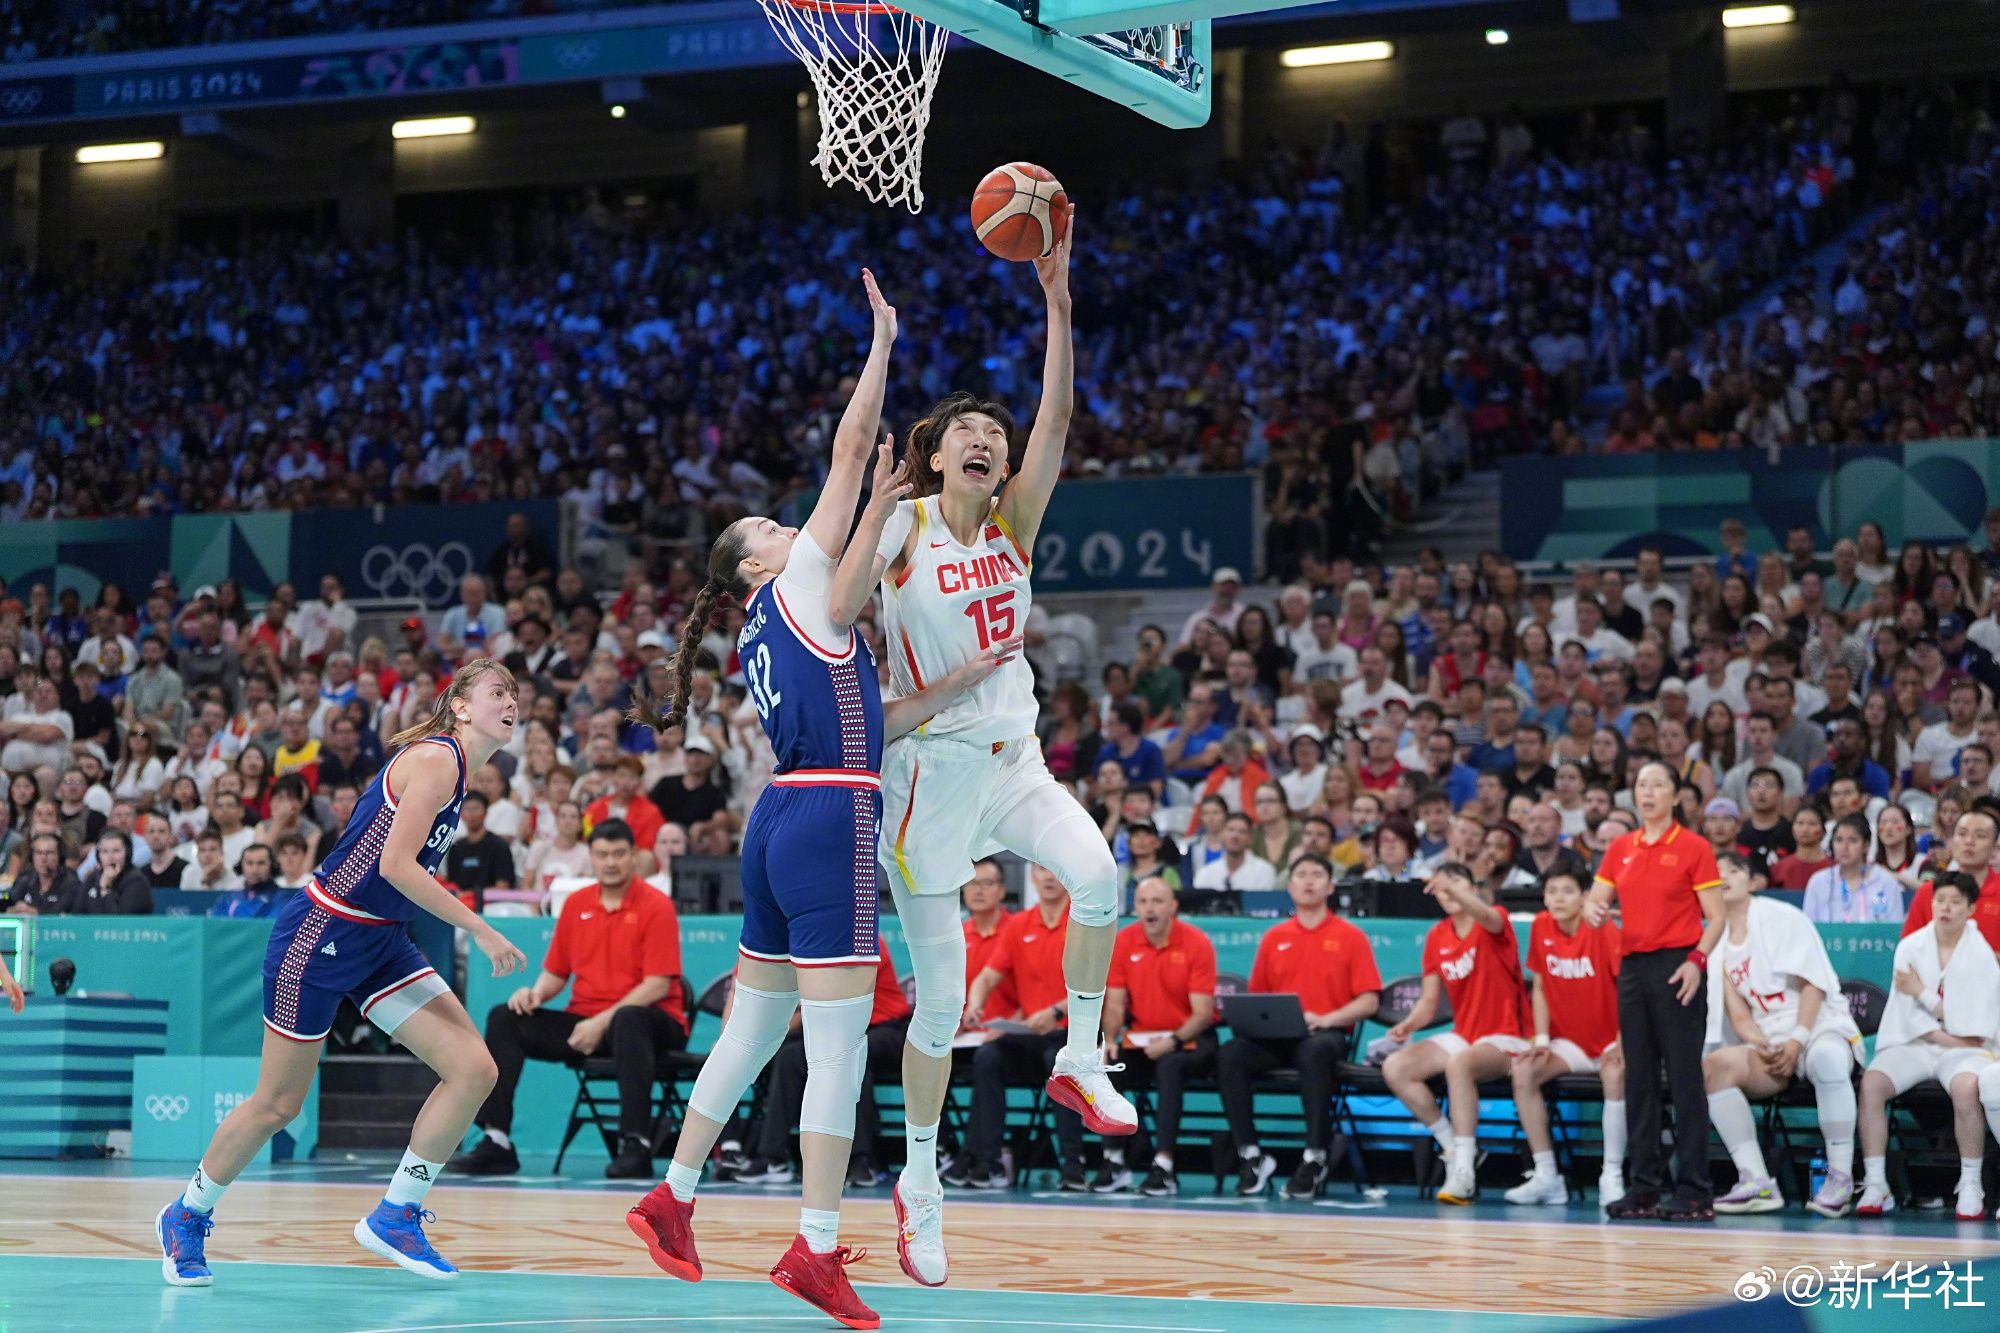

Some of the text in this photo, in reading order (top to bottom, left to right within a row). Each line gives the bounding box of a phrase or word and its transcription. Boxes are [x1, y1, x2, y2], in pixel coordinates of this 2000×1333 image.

[103, 70, 262, 105] PARIS 2024
[936, 551, 1023, 594] CHINA
[1037, 528, 1212, 581] 2024
[964, 590, 1015, 651] 15
[748, 642, 781, 720] 32
[1545, 953, 1594, 979] CHINA
[404, 1166, 431, 1182] PEAK
